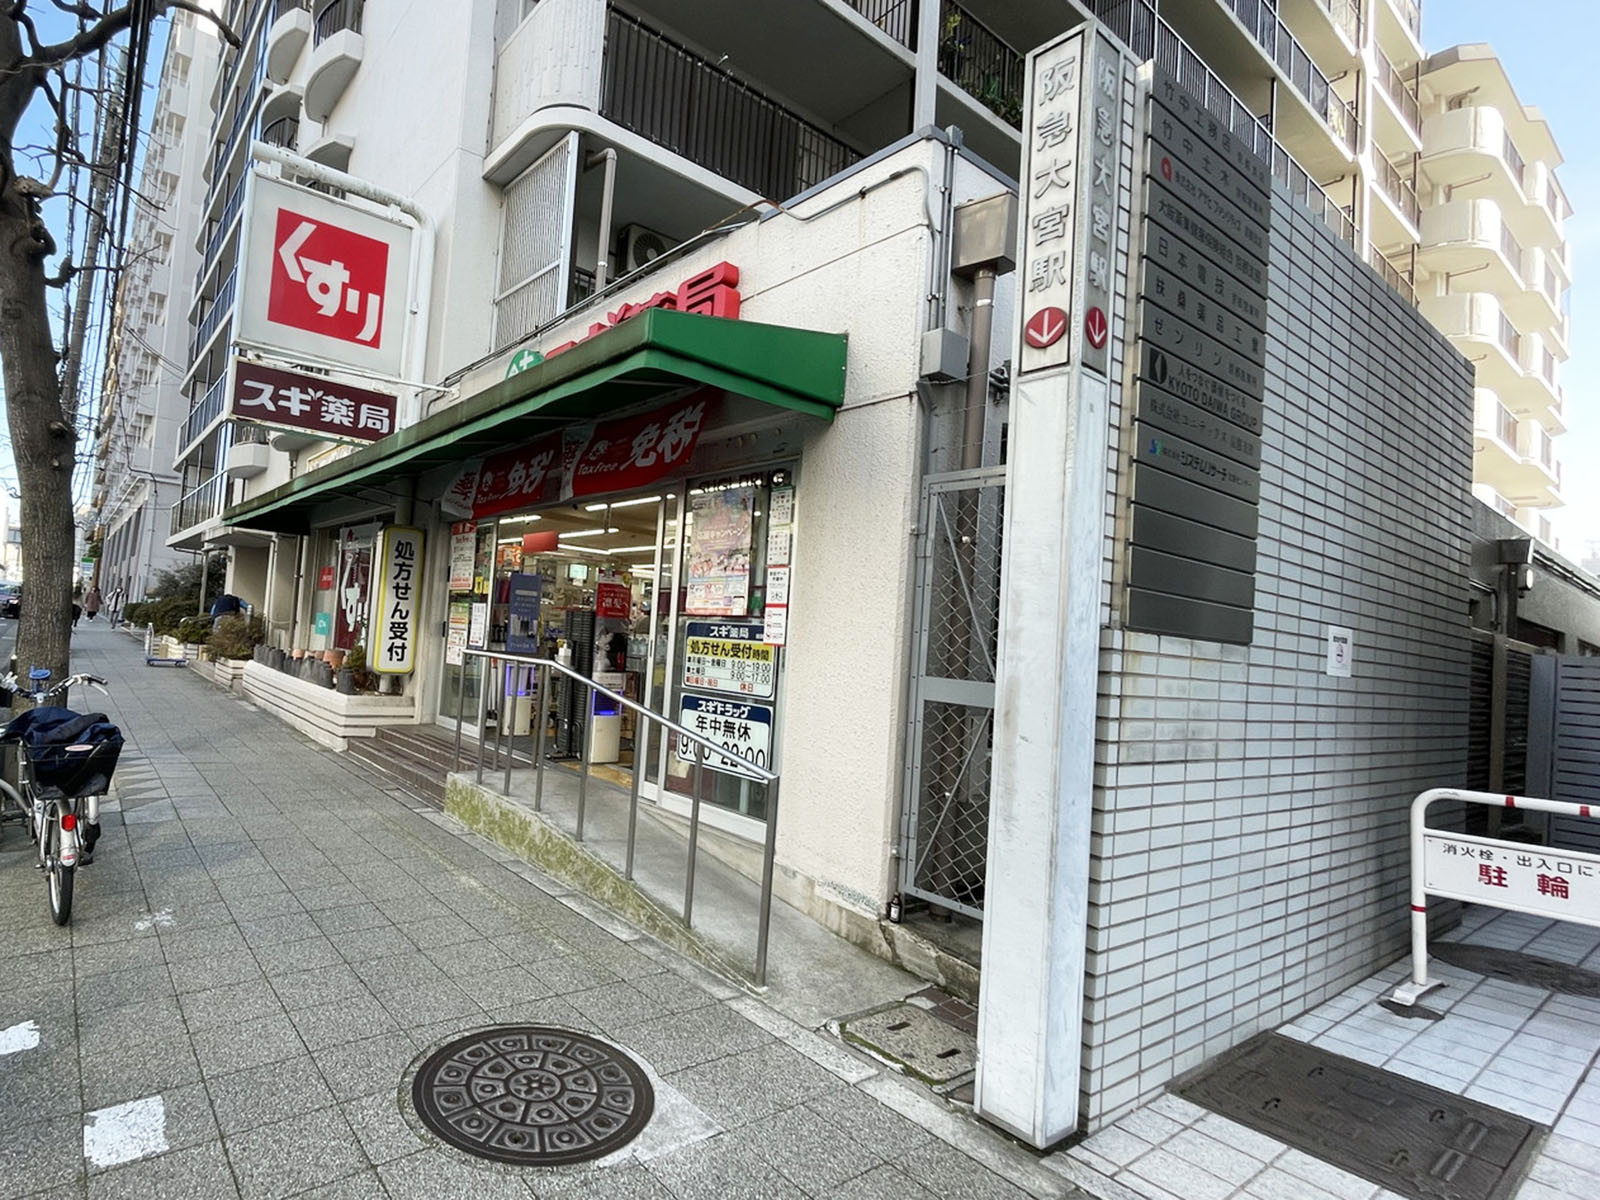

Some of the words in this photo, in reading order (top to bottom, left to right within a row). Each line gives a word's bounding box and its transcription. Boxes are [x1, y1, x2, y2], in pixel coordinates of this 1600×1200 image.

[1029, 56, 1076, 293] 阪急大宮駅
[1088, 56, 1117, 293] 阪急大宮駅
[1161, 116, 1230, 190] 竹中土木
[279, 221, 381, 342] くすり
[1157, 234, 1225, 298] 日本電技
[1153, 314, 1222, 369] ゼンリン
[1155, 273, 1259, 356] 扶桑薬品工業
[239, 380, 391, 434] スギ薬局
[1167, 374, 1199, 404] KYOTO
[1200, 389, 1229, 417] DAIWA
[1229, 404, 1257, 431] GROUP
[620, 402, 705, 485] 免税
[387, 540, 415, 662] 処方せん受付
[690, 640, 769, 661] 処方せん受付時間
[709, 625, 749, 639] スギ薬局
[697, 701, 750, 718] スギドラッグ
[740, 683, 753, 692] 休日
[696, 716, 752, 742] 年中無休
[1443, 842, 1600, 878] 消火栓・出入口に
[1478, 863, 1570, 899] 駐輪
